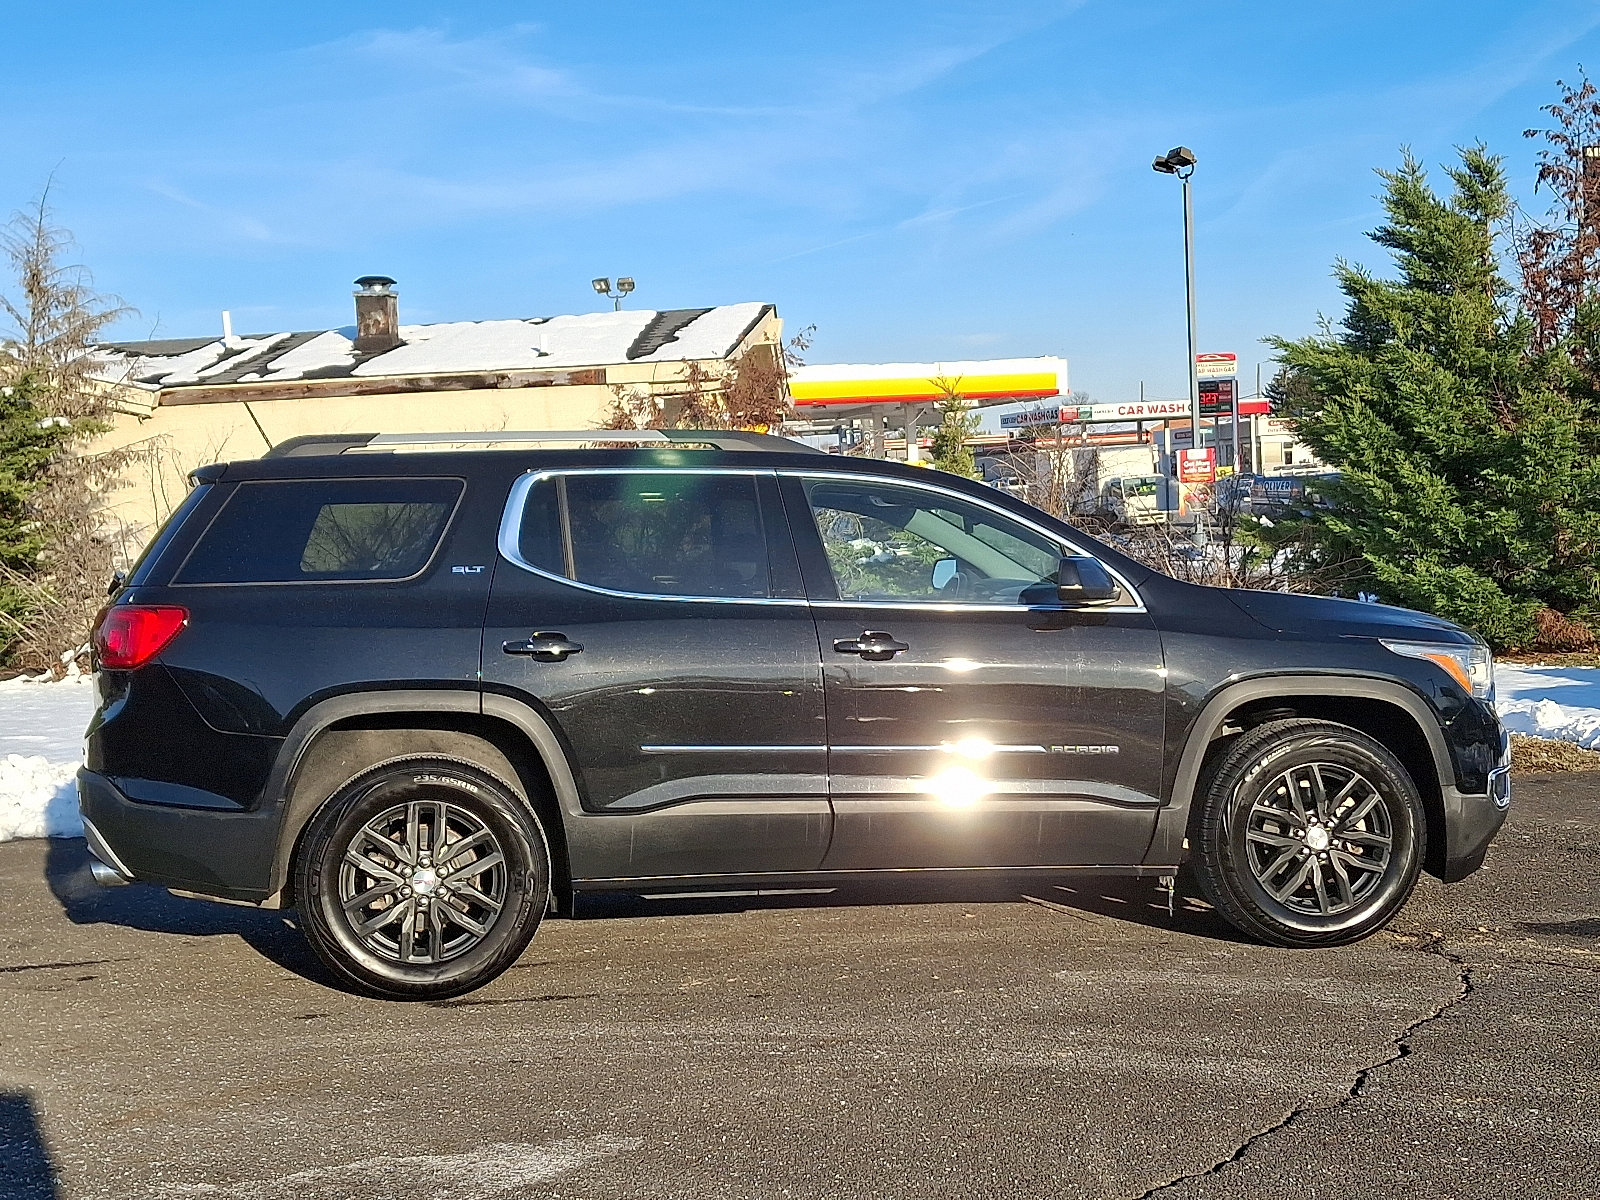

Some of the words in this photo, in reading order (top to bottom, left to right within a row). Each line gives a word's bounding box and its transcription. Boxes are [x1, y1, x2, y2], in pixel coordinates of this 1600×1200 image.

[1118, 405, 1144, 415] CAR
[1147, 403, 1185, 414] WASH
[1263, 481, 1291, 491] OLIVER
[1050, 745, 1119, 753] ACADIA
[413, 774, 478, 793] 235/65R18
